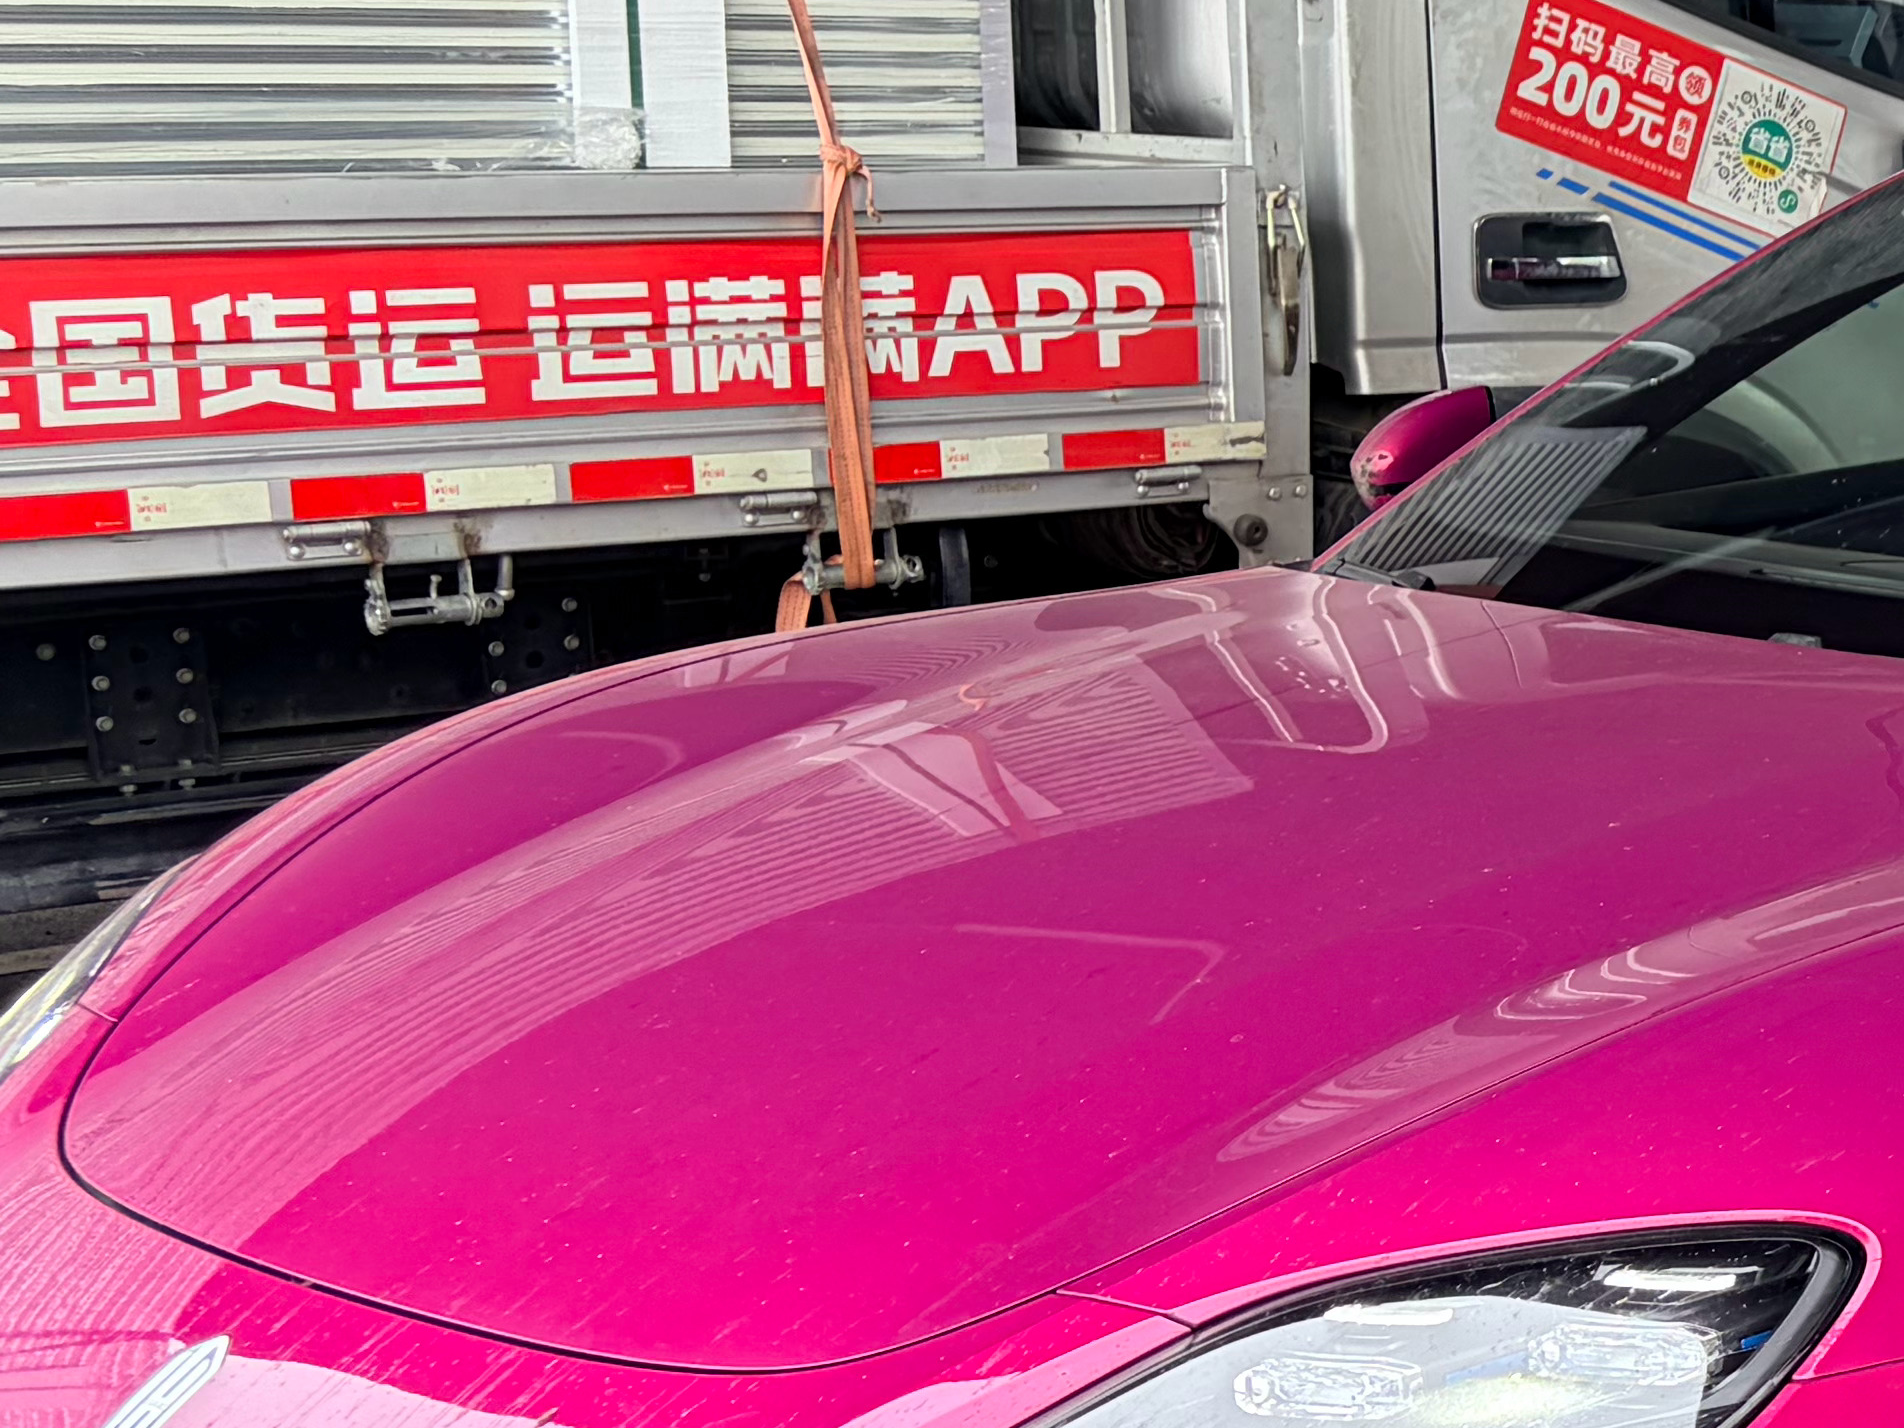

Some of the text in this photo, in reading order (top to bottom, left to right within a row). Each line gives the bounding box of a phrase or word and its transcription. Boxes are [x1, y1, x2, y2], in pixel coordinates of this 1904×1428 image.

[1748, 127, 1790, 163] 省省
[0, 287, 486, 431] 国货运
